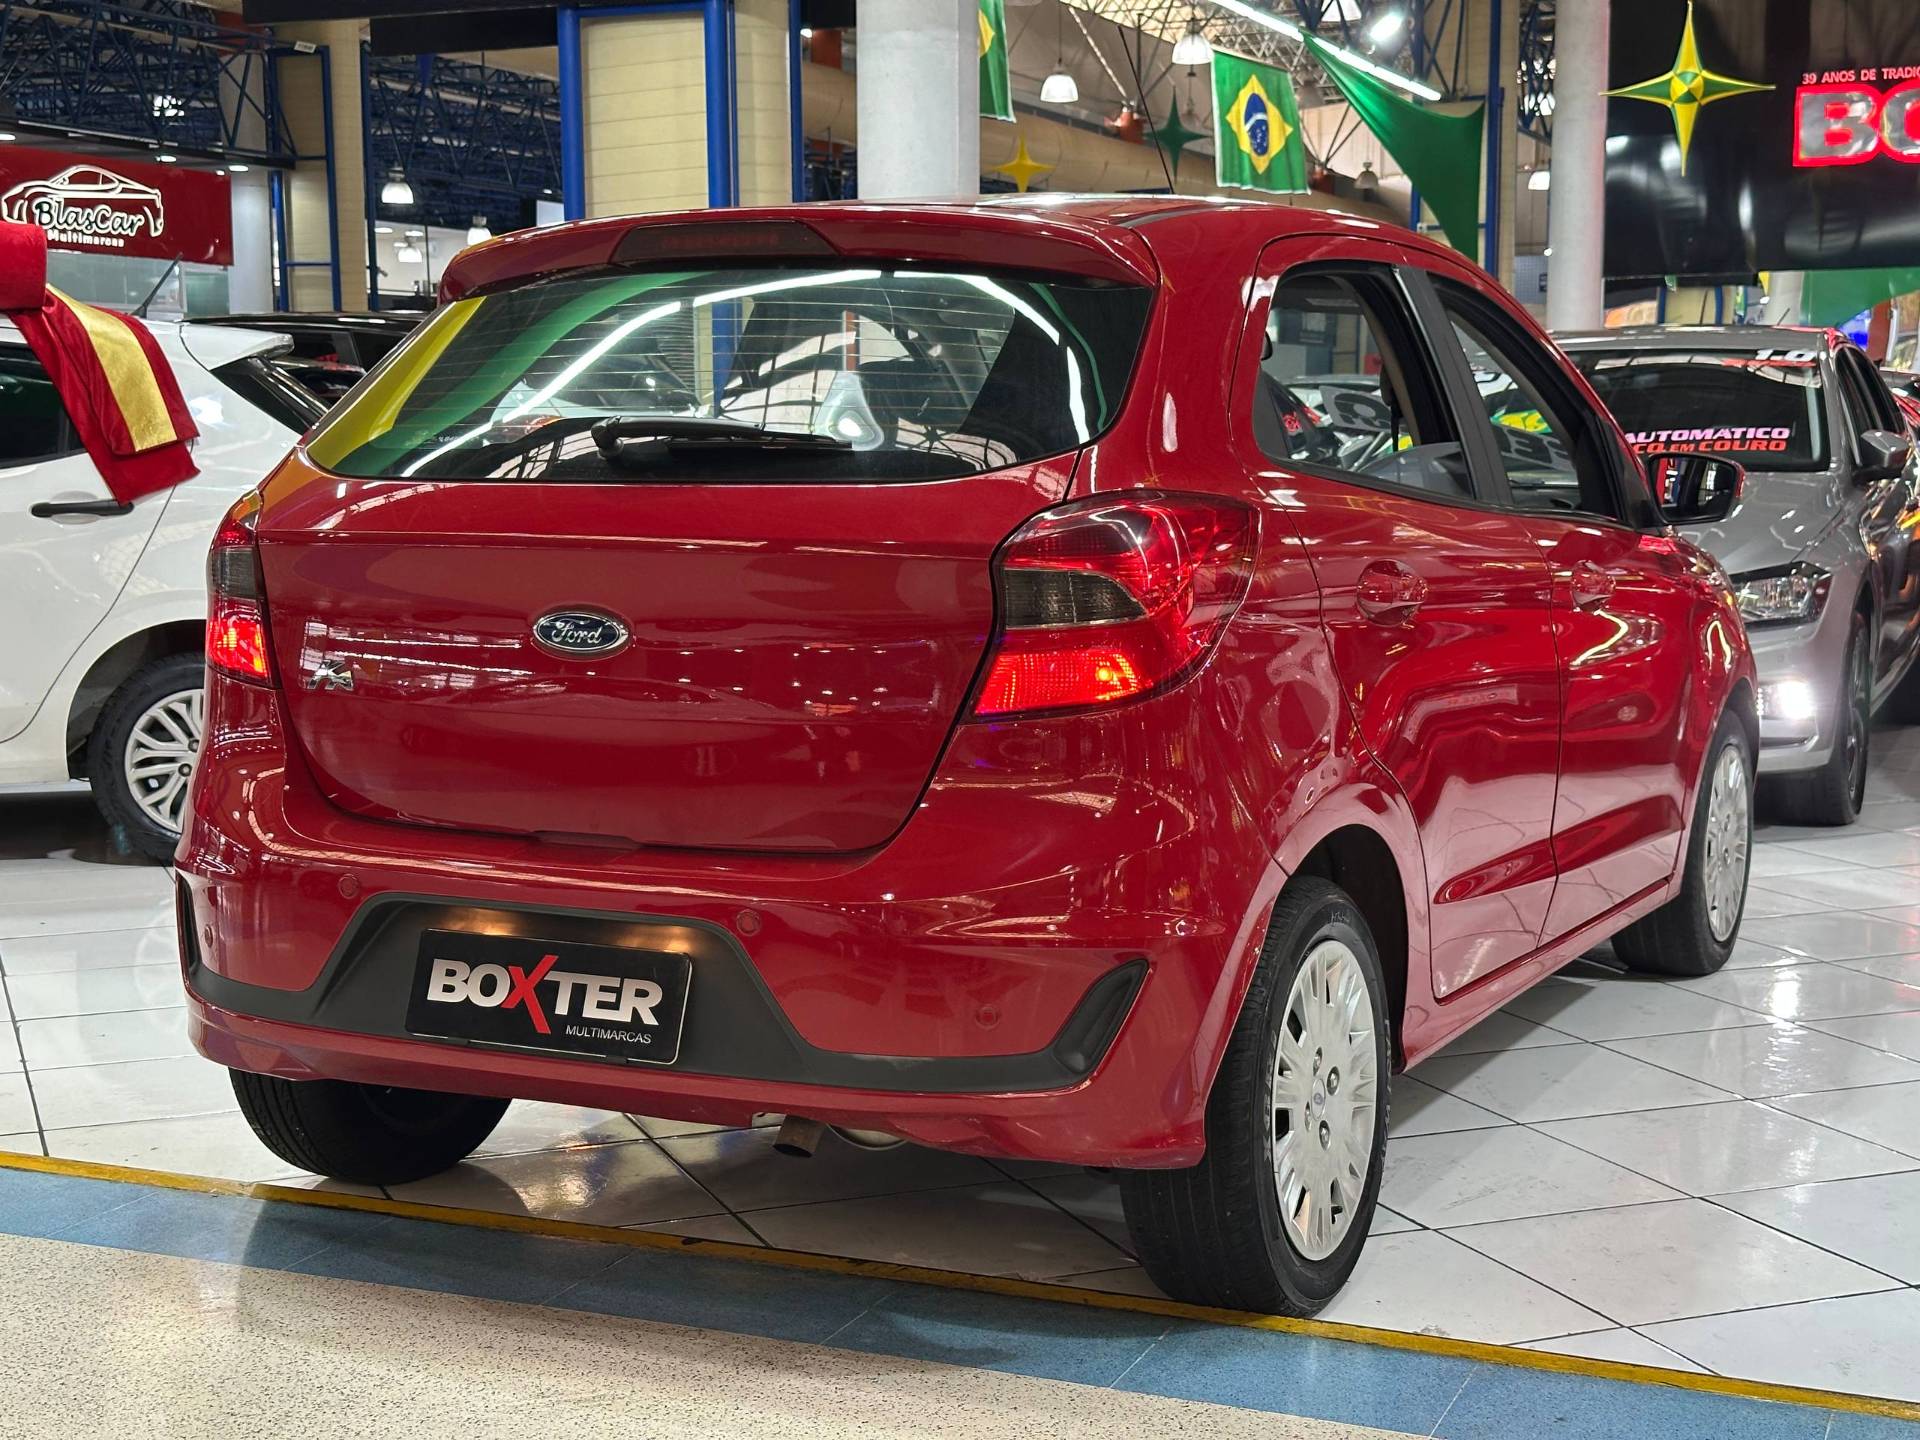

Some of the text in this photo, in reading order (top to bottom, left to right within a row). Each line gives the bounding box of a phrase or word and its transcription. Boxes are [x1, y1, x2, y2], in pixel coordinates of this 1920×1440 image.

[1802, 73, 1816, 84] 39
[1821, 71, 1855, 83] ANOS
[1861, 69, 1876, 80] DE
[33, 197, 145, 236] BlasCar
[1755, 348, 1816, 362] 1.0
[1699, 440, 1786, 451] COURO
[551, 621, 603, 643] Ford
[426, 954, 663, 1034] BOXTER
[566, 1024, 651, 1044] MULTIMARCAS
